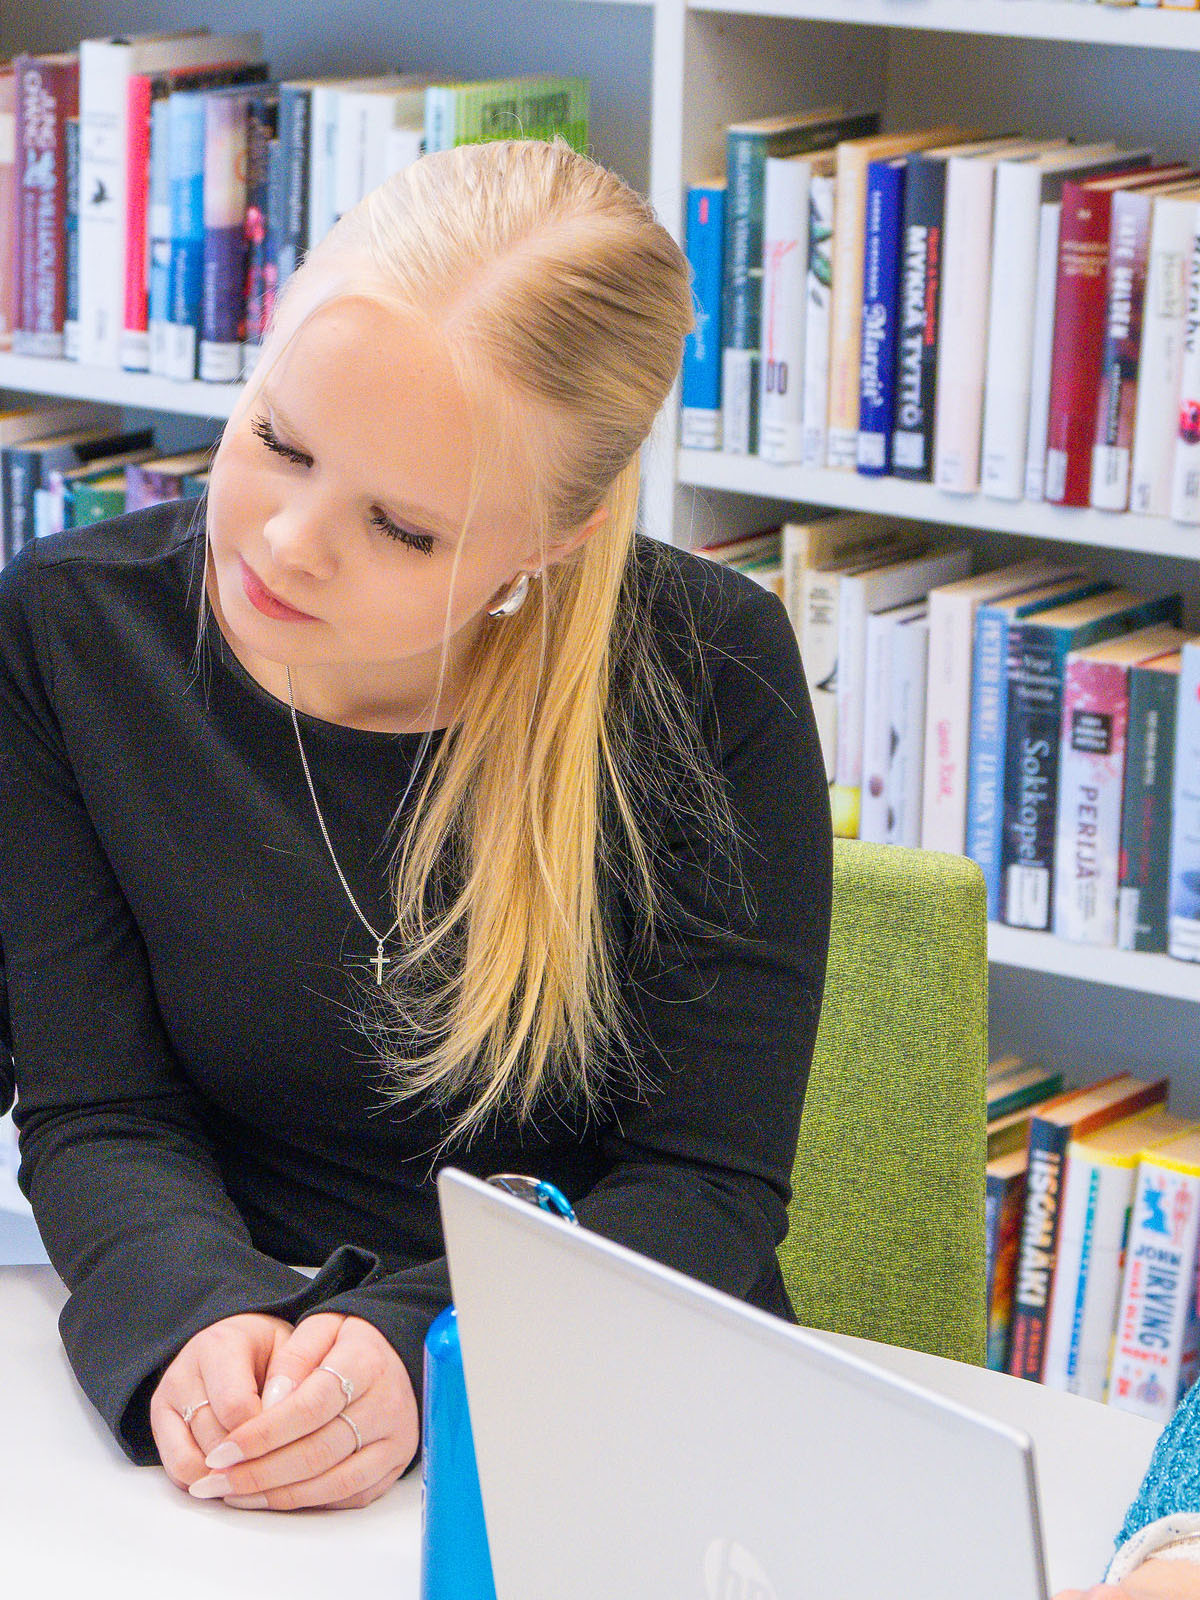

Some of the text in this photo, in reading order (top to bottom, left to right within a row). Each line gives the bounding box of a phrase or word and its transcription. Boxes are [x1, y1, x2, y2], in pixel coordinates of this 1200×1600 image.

[903, 226, 929, 329] MYKKÄ
[900, 335, 924, 426] TYTTÖ
[1012, 738, 1049, 867] Sokkopel
[1076, 785, 1104, 880] PERIJÄ
[1017, 1160, 1060, 1308] ISOMÄKI
[1135, 1244, 1183, 1266] JOHN
[1138, 1264, 1180, 1350] IRVING
